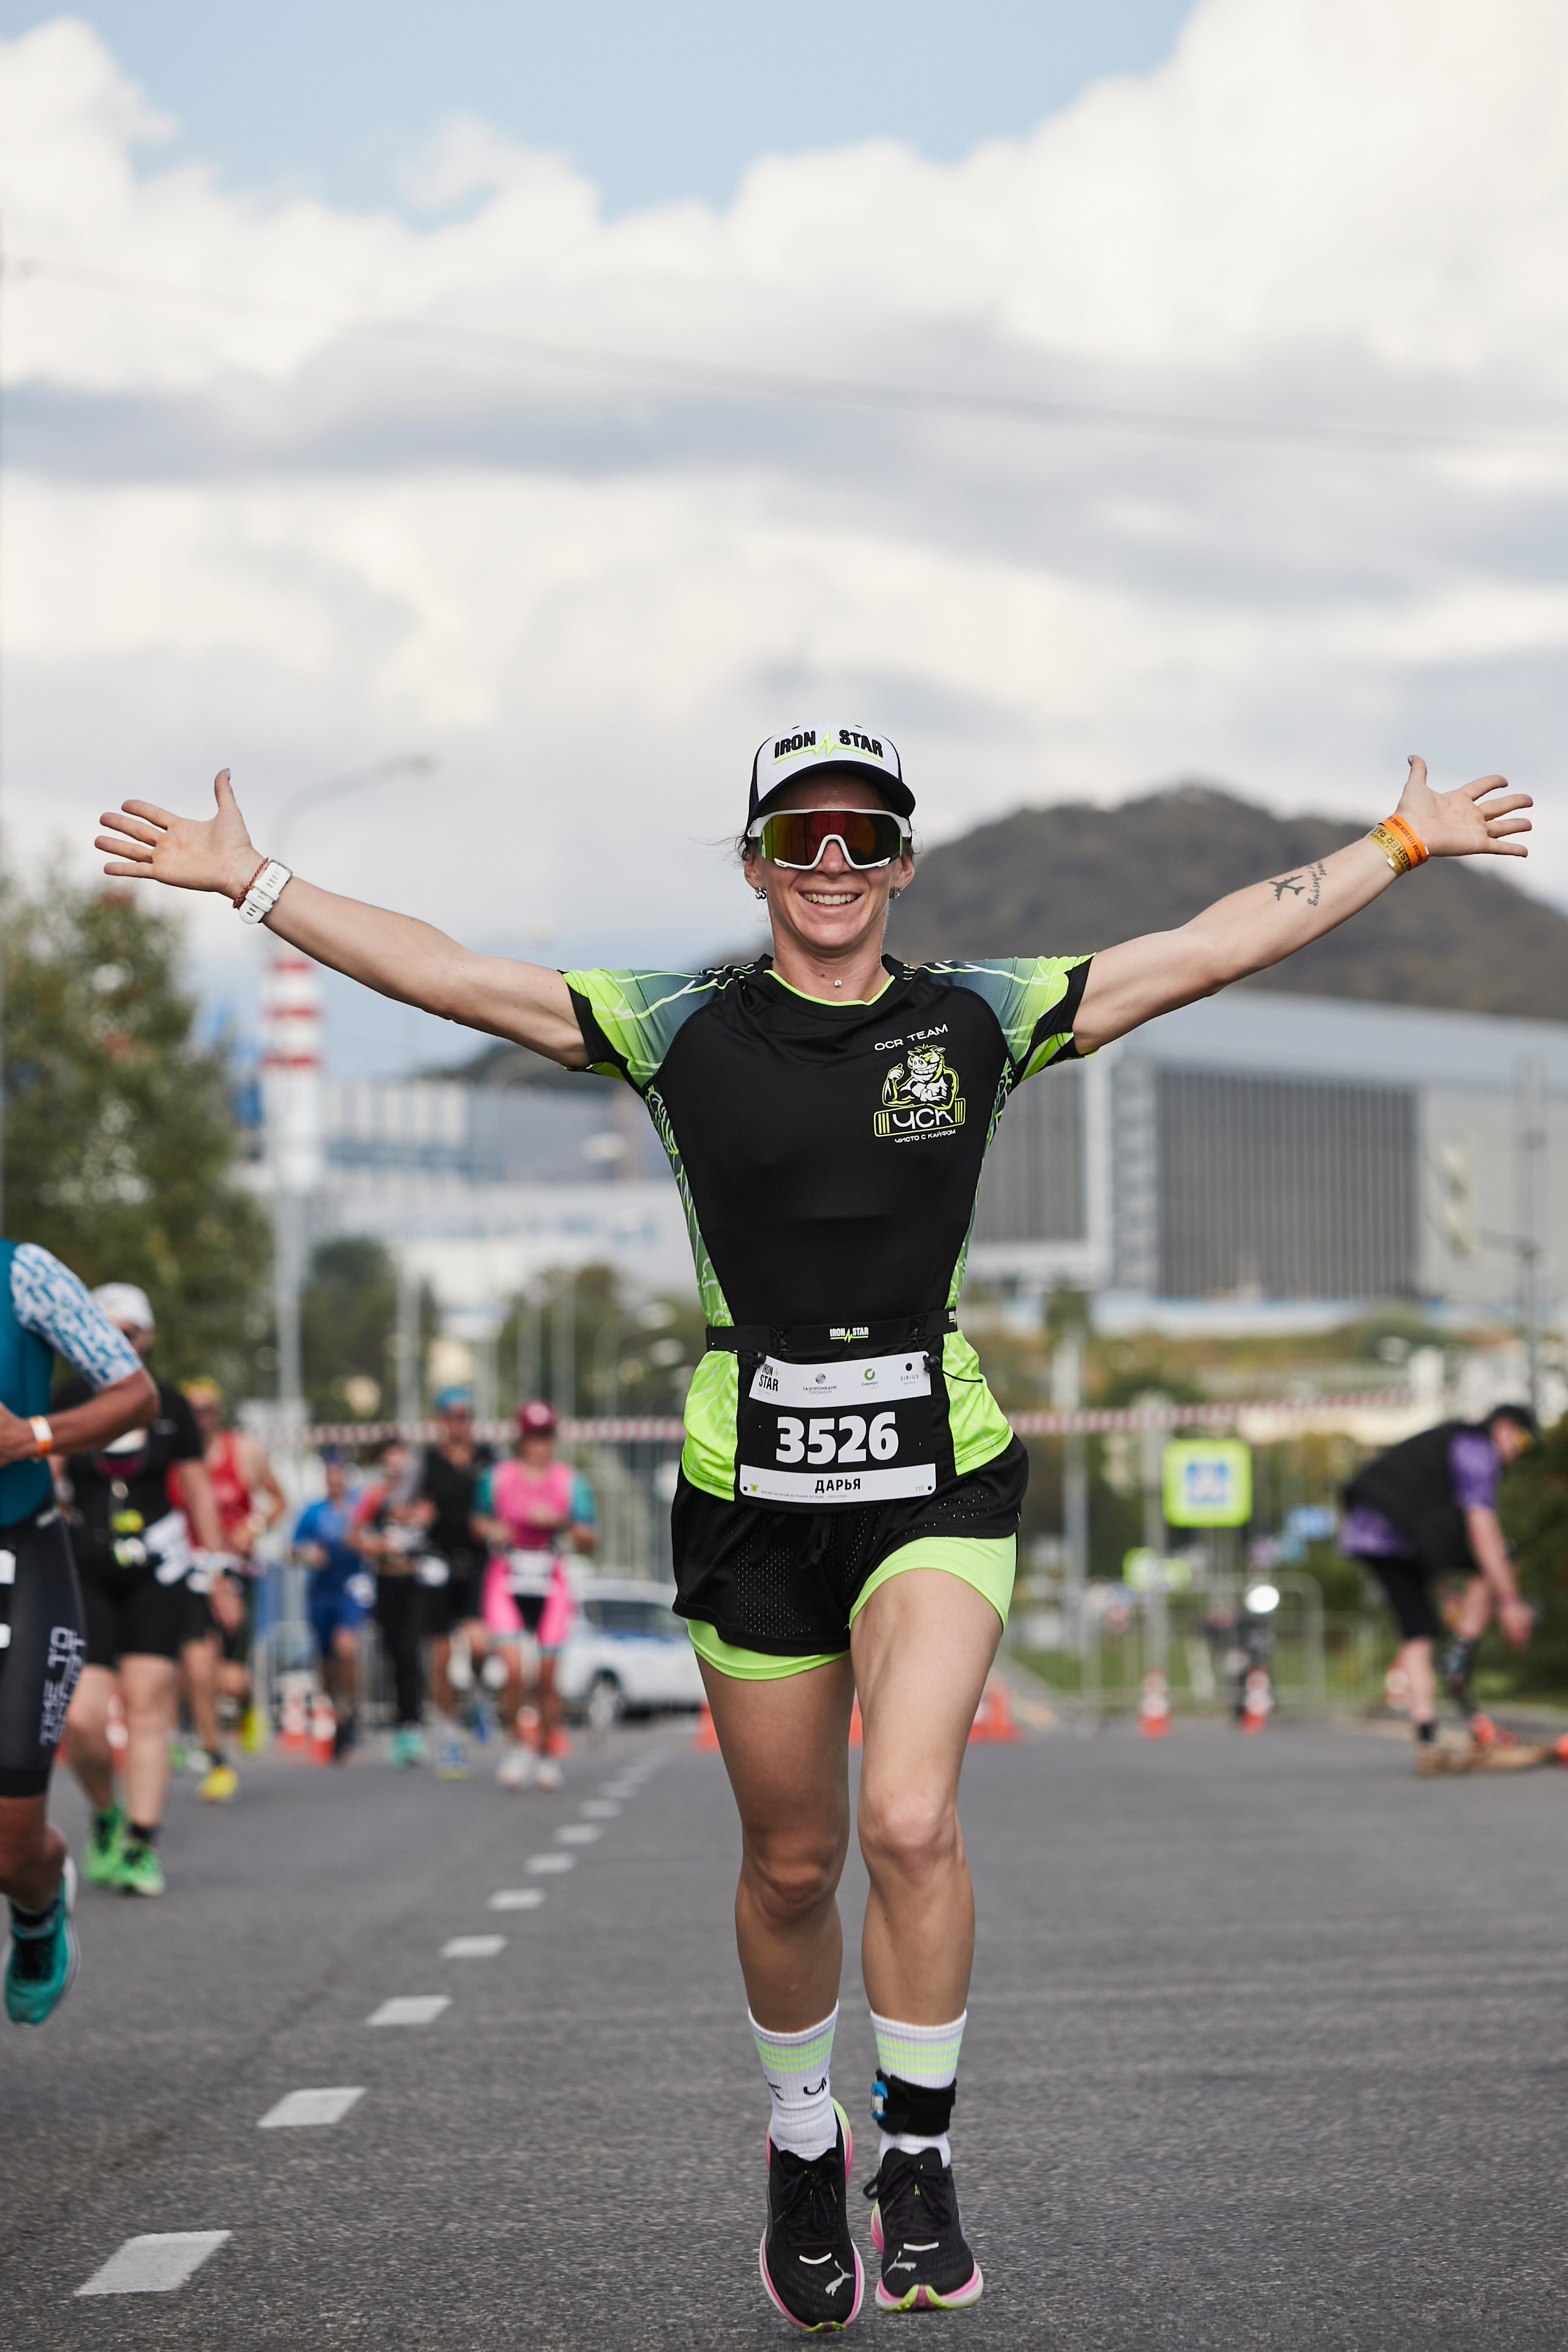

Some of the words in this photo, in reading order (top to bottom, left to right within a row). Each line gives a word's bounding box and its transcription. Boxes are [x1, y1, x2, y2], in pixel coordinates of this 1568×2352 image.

[774, 731, 816, 758] IRON
[839, 729, 883, 758] STAR
[874, 1039, 903, 1050] OCR
[907, 1023, 949, 1041] TEAM
[894, 1134, 919, 1144] ЧИСТО
[927, 1129, 956, 1139] КАЙФОМ
[829, 1328, 845, 1337] IRON
[852, 1327, 869, 1336] STAR
[761, 1363, 774, 1376] IRON
[758, 1374, 778, 1392] STAR
[776, 1411, 899, 1464] 3526
[815, 1478, 861, 1494] ДАРЬЯ
